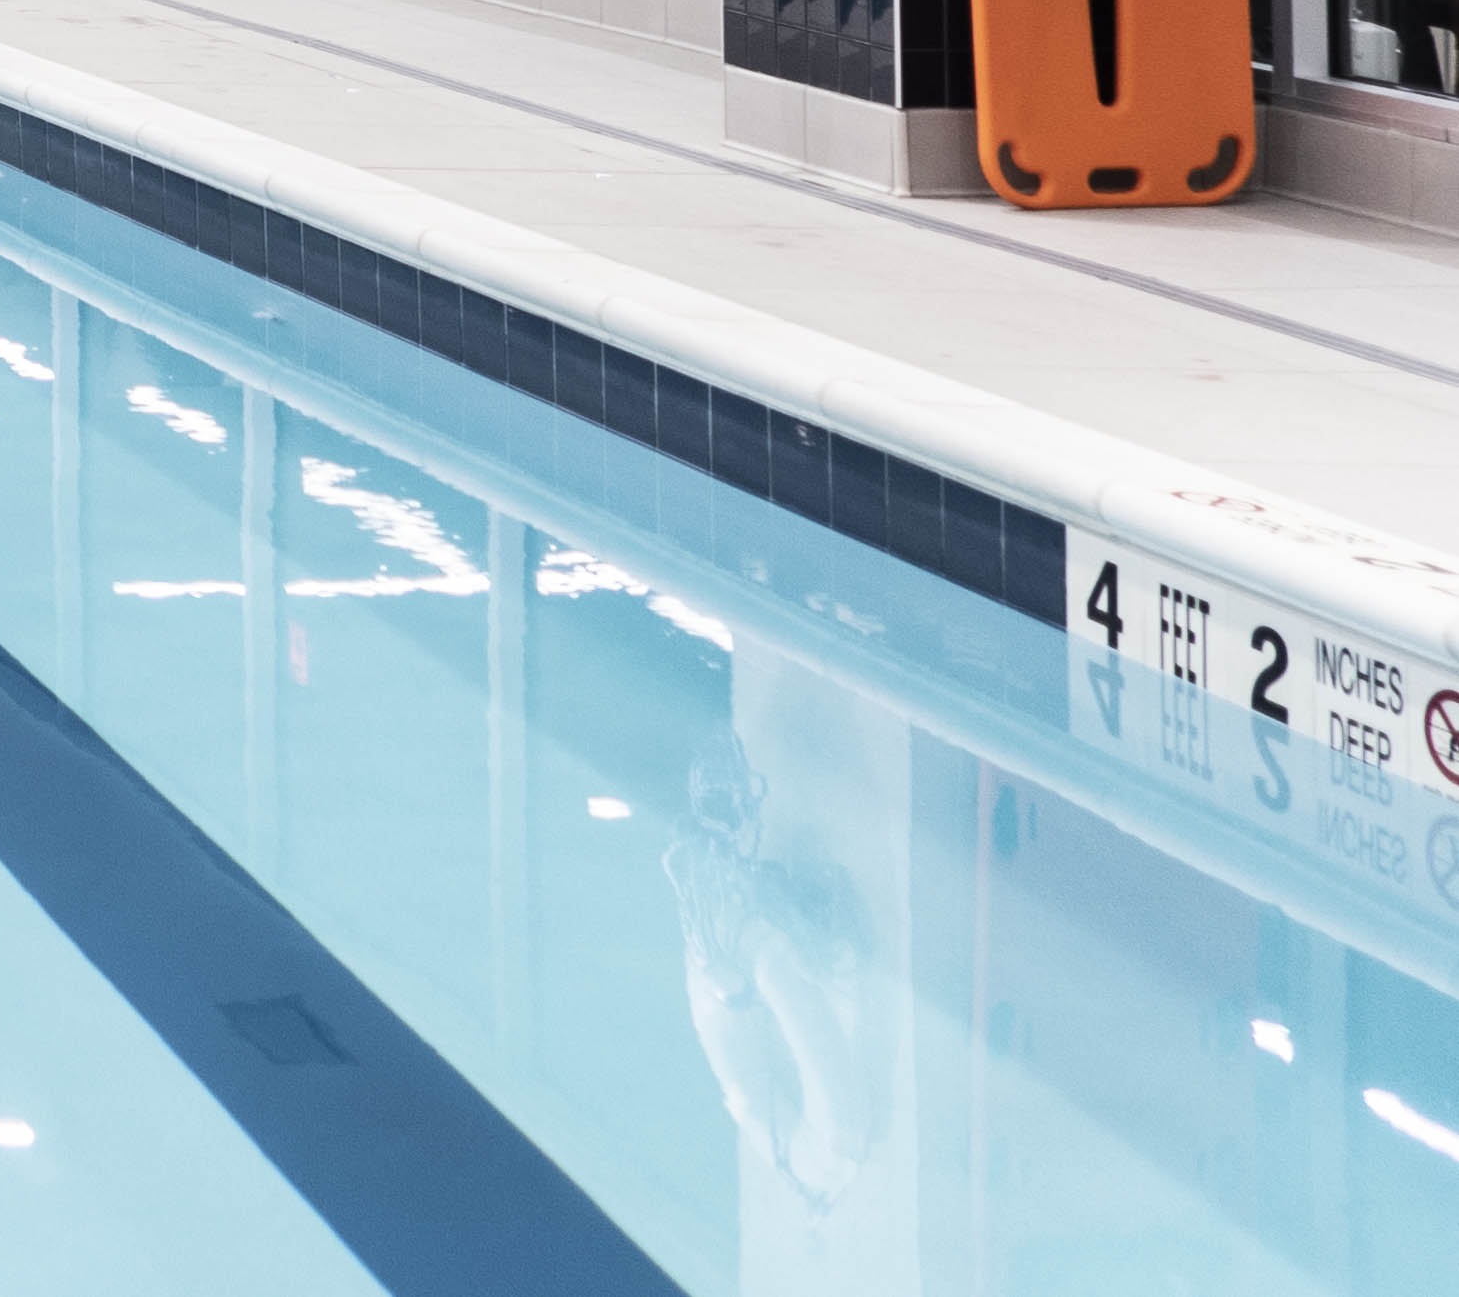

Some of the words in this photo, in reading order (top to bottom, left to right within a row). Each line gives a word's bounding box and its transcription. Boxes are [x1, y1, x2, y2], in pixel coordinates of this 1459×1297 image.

[1087, 560, 1123, 650] 4
[1159, 582, 1210, 690] FEET
[1251, 625, 1288, 725] 2
[1315, 636, 1404, 716] INCHES
[1330, 710, 1391, 770] DEEP
